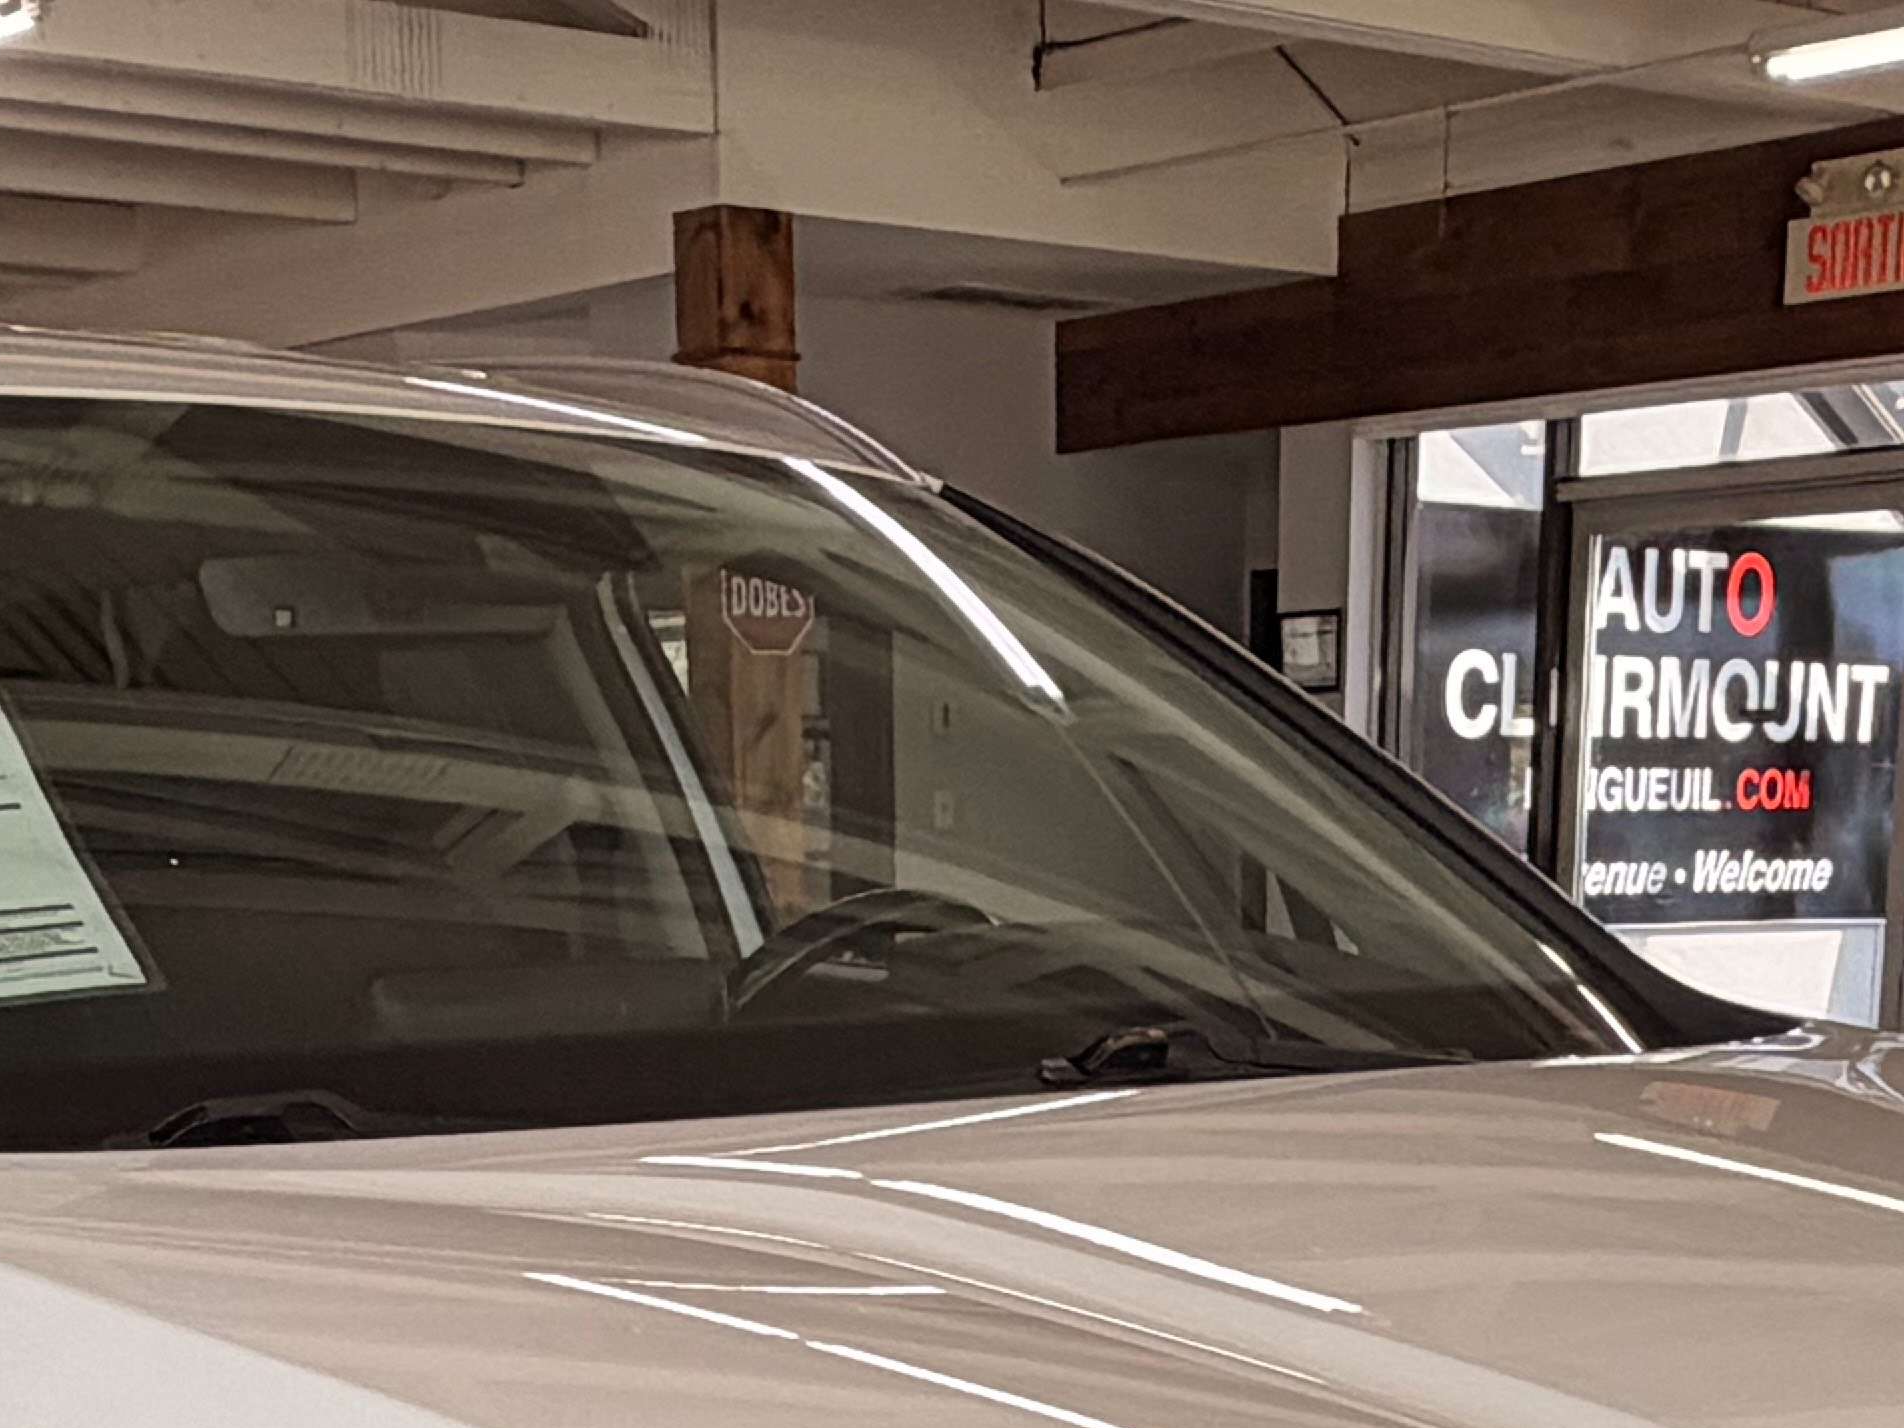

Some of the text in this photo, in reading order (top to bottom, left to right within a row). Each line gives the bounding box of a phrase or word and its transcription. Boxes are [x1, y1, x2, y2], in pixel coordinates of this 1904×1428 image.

[1595, 547, 1777, 636] AUTO
[1445, 649, 1890, 744] CLIRMOUNT
[1693, 849, 1833, 893] Welcome
